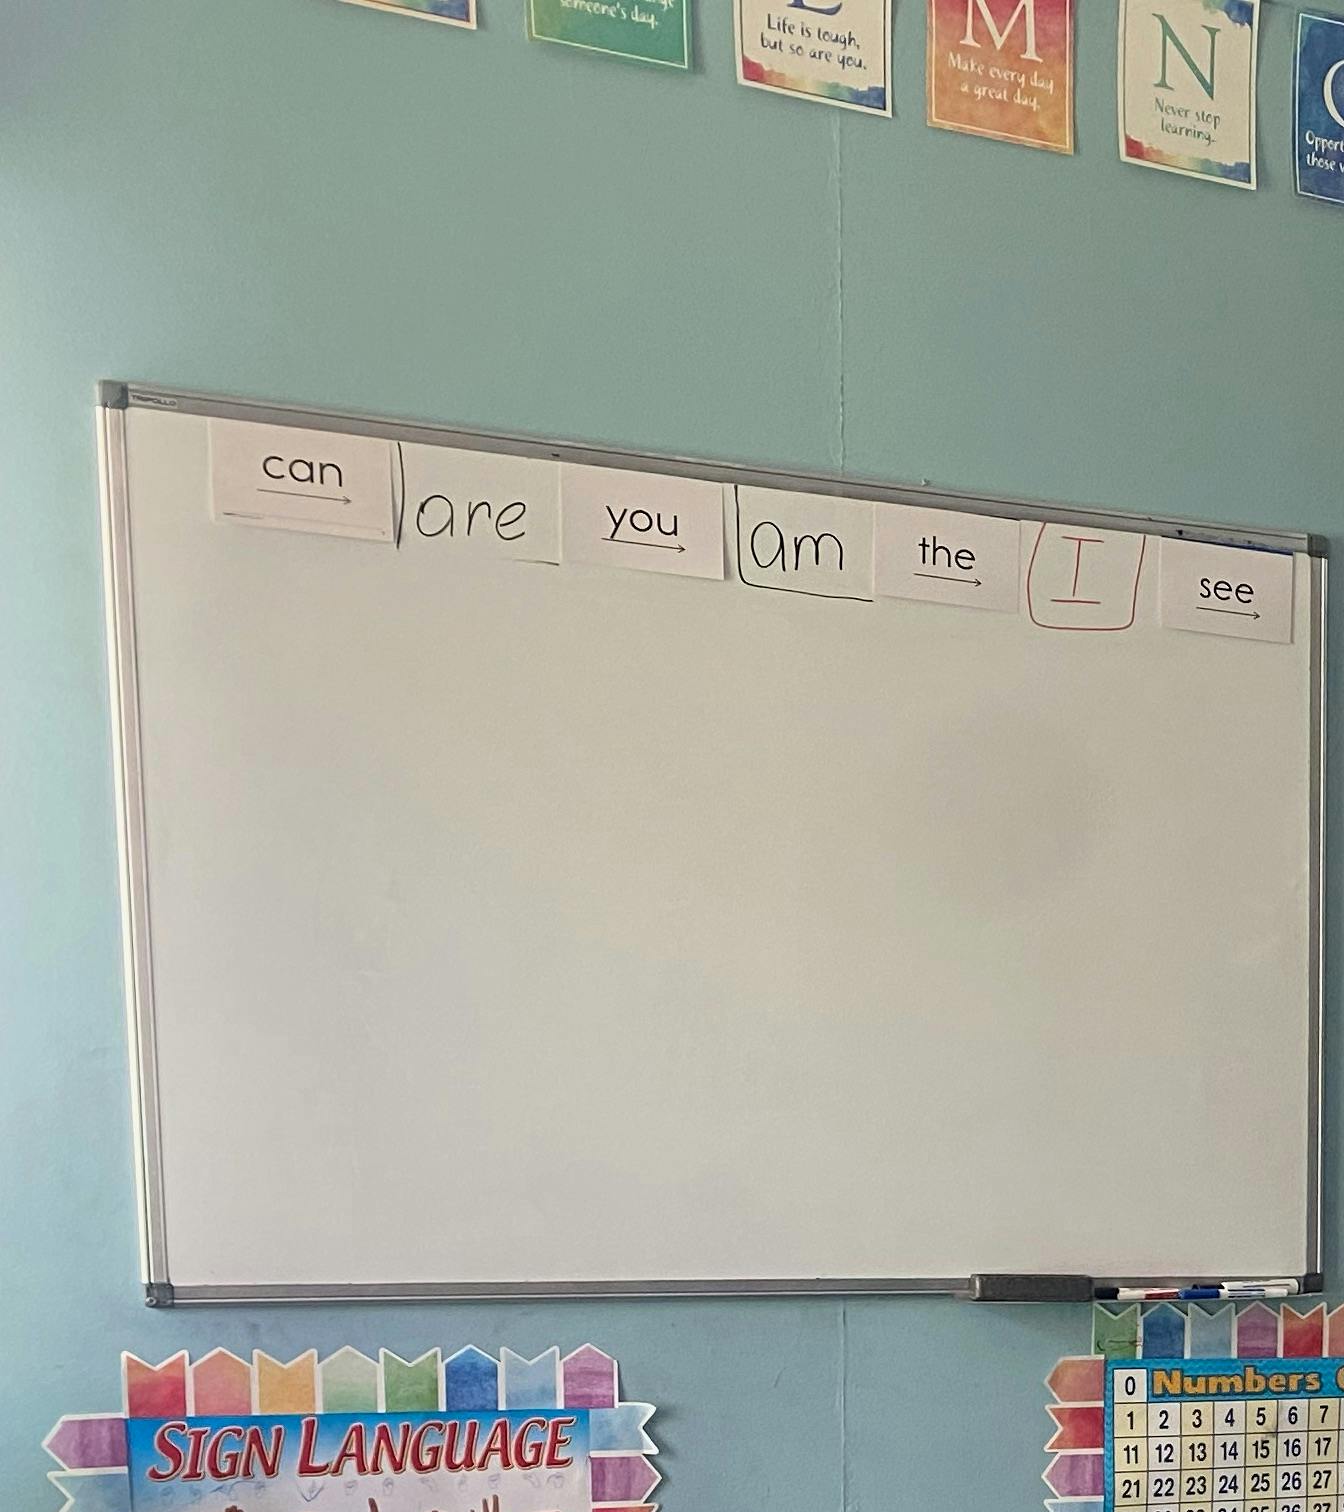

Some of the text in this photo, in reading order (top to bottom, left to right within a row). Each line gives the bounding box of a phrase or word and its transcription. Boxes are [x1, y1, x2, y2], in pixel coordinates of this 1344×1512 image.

[767, 13, 862, 51] Life is tough,
[959, 0, 1044, 63] M
[760, 32, 867, 72] but so are you.
[1152, 13, 1222, 100] N
[947, 51, 1055, 95] Make every day
[960, 81, 969, 94] a
[974, 83, 1009, 104] great
[1154, 97, 1221, 130] Never stop
[1160, 120, 1217, 146] learning.
[1306, 152, 1336, 172] those
[262, 454, 344, 488] can
[416, 494, 526, 541] are
[605, 504, 679, 539] you
[750, 521, 844, 572] am
[918, 535, 976, 571] the
[1051, 536, 1104, 604] I
[1199, 576, 1255, 604] see
[1152, 1366, 1322, 1397] Numbers
[147, 1414, 577, 1483] SIGN LANGUAGE
[1155, 1443, 1175, 1464] 12
